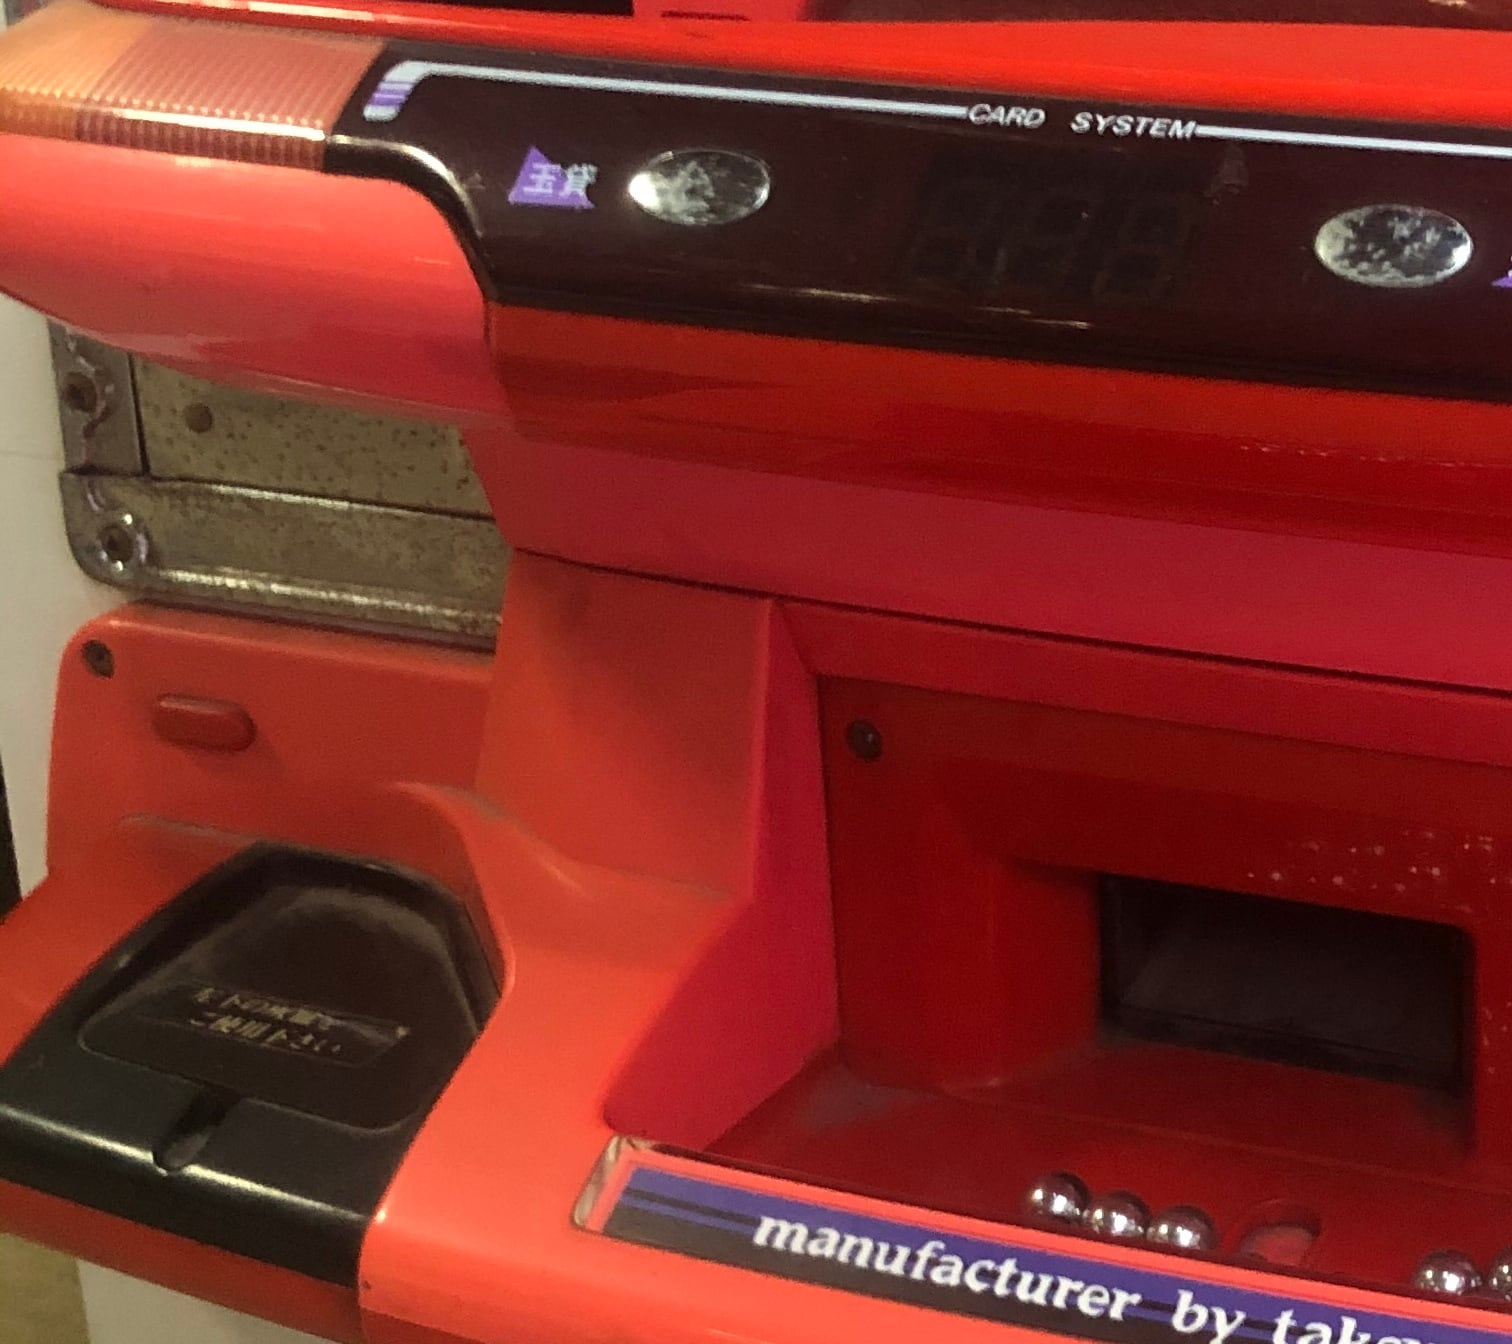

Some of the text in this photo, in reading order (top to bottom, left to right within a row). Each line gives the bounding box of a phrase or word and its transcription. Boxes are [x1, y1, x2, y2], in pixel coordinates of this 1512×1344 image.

[968, 103, 1198, 140] CARD SYSTEM
[752, 1213, 1142, 1321] manufacturer
